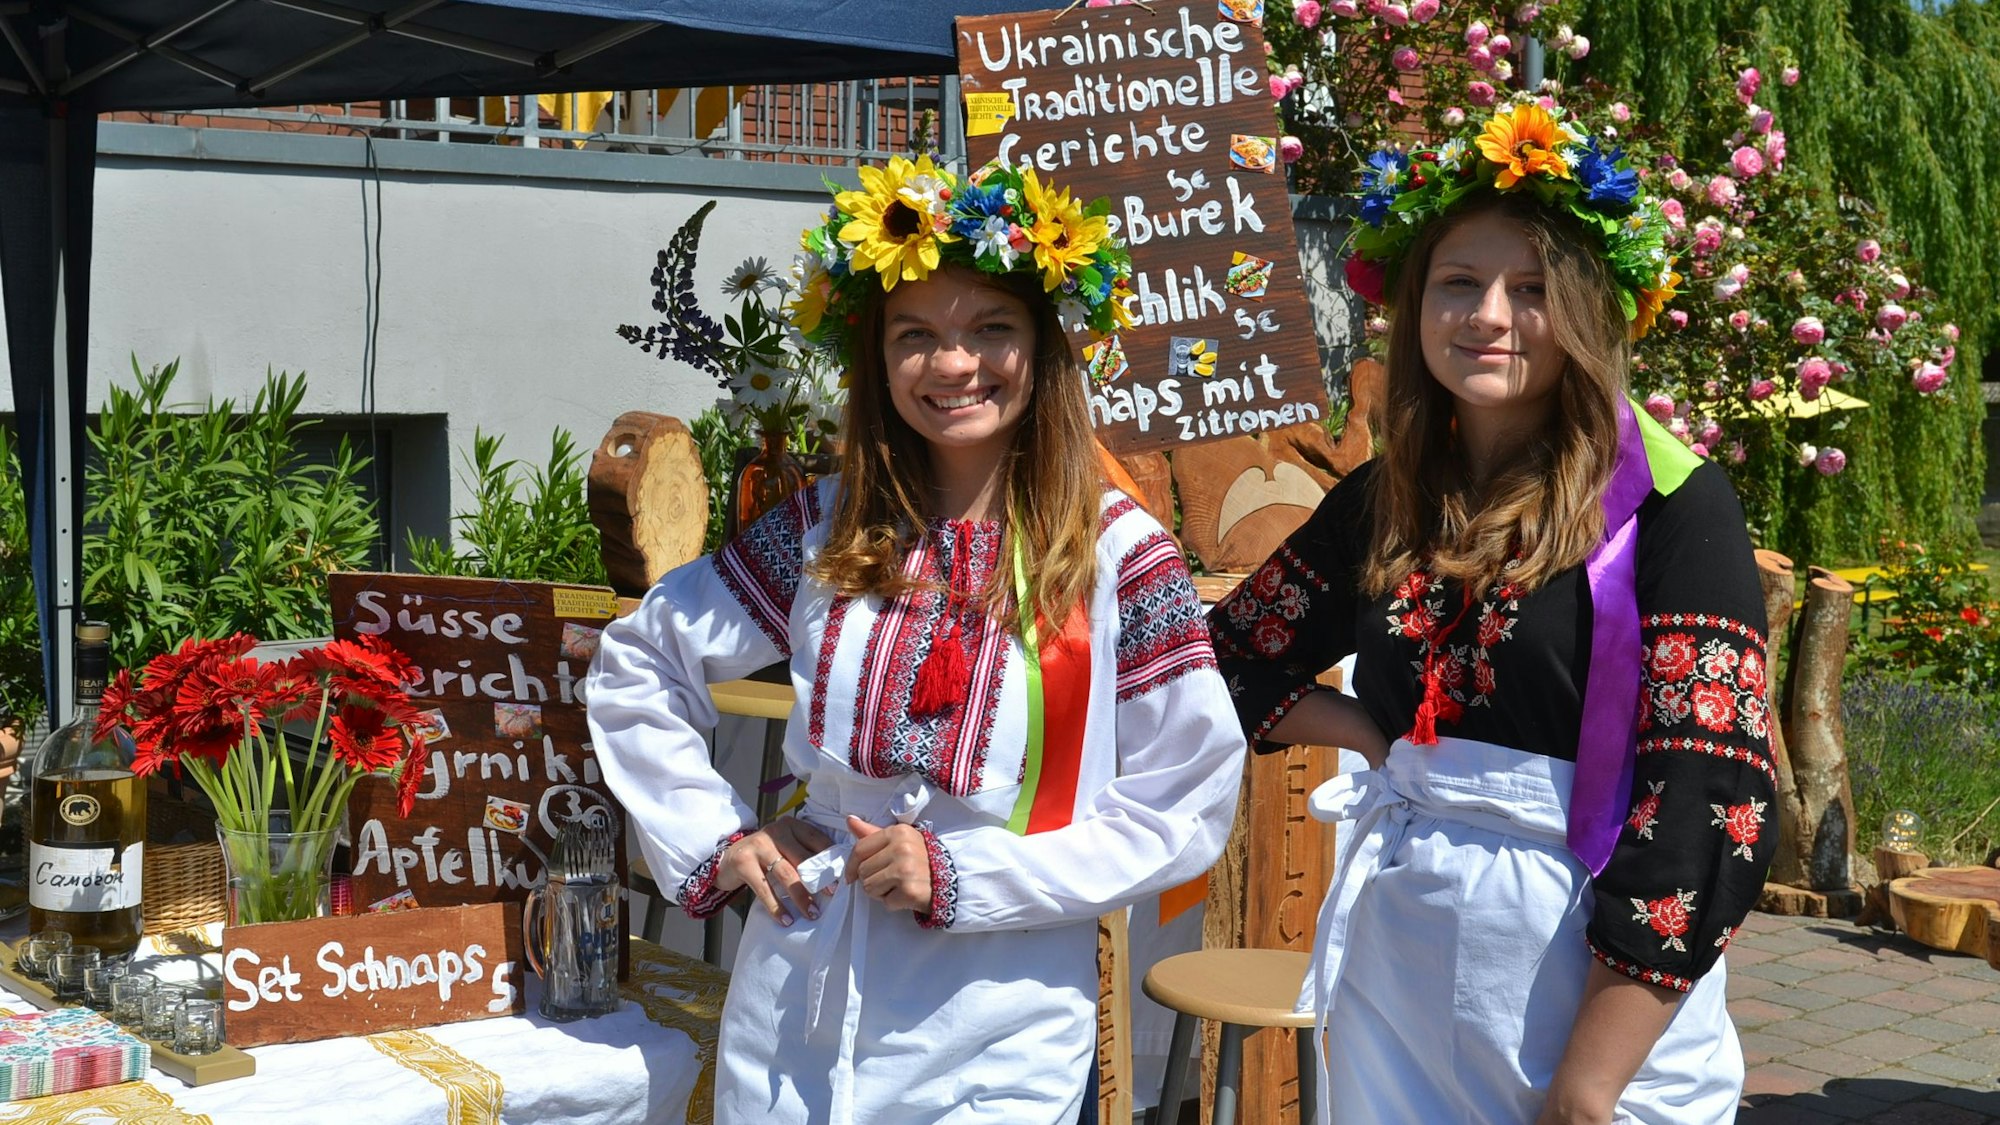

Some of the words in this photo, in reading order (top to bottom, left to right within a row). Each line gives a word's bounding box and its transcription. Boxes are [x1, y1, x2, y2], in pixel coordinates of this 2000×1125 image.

[976, 7, 1245, 72] Ukrainische
[998, 115, 1210, 174] Gerichte
[1202, 353, 1287, 407] mit
[352, 590, 530, 645] Süsse
[400, 653, 589, 704] ericht
[414, 734, 601, 801] yrniki
[352, 818, 549, 891] Apfelku
[224, 947, 304, 1013] Set
[317, 941, 487, 1003] Schnaps
